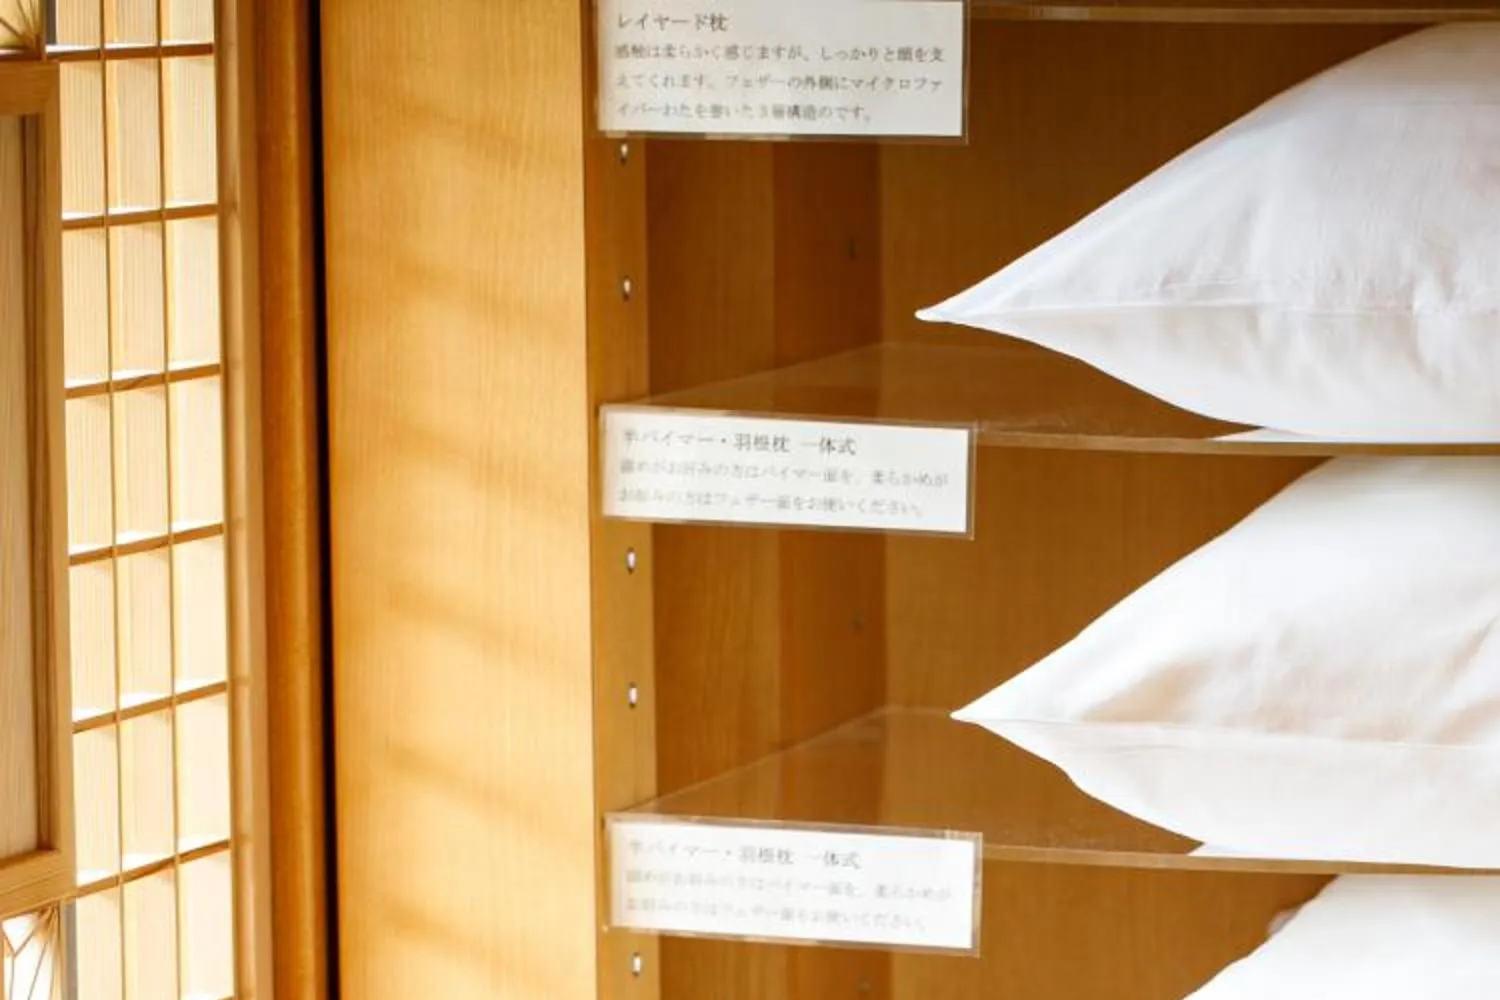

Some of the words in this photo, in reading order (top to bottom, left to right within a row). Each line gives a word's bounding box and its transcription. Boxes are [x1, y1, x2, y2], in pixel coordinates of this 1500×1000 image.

[617, 12, 730, 33] レイヤード枕
